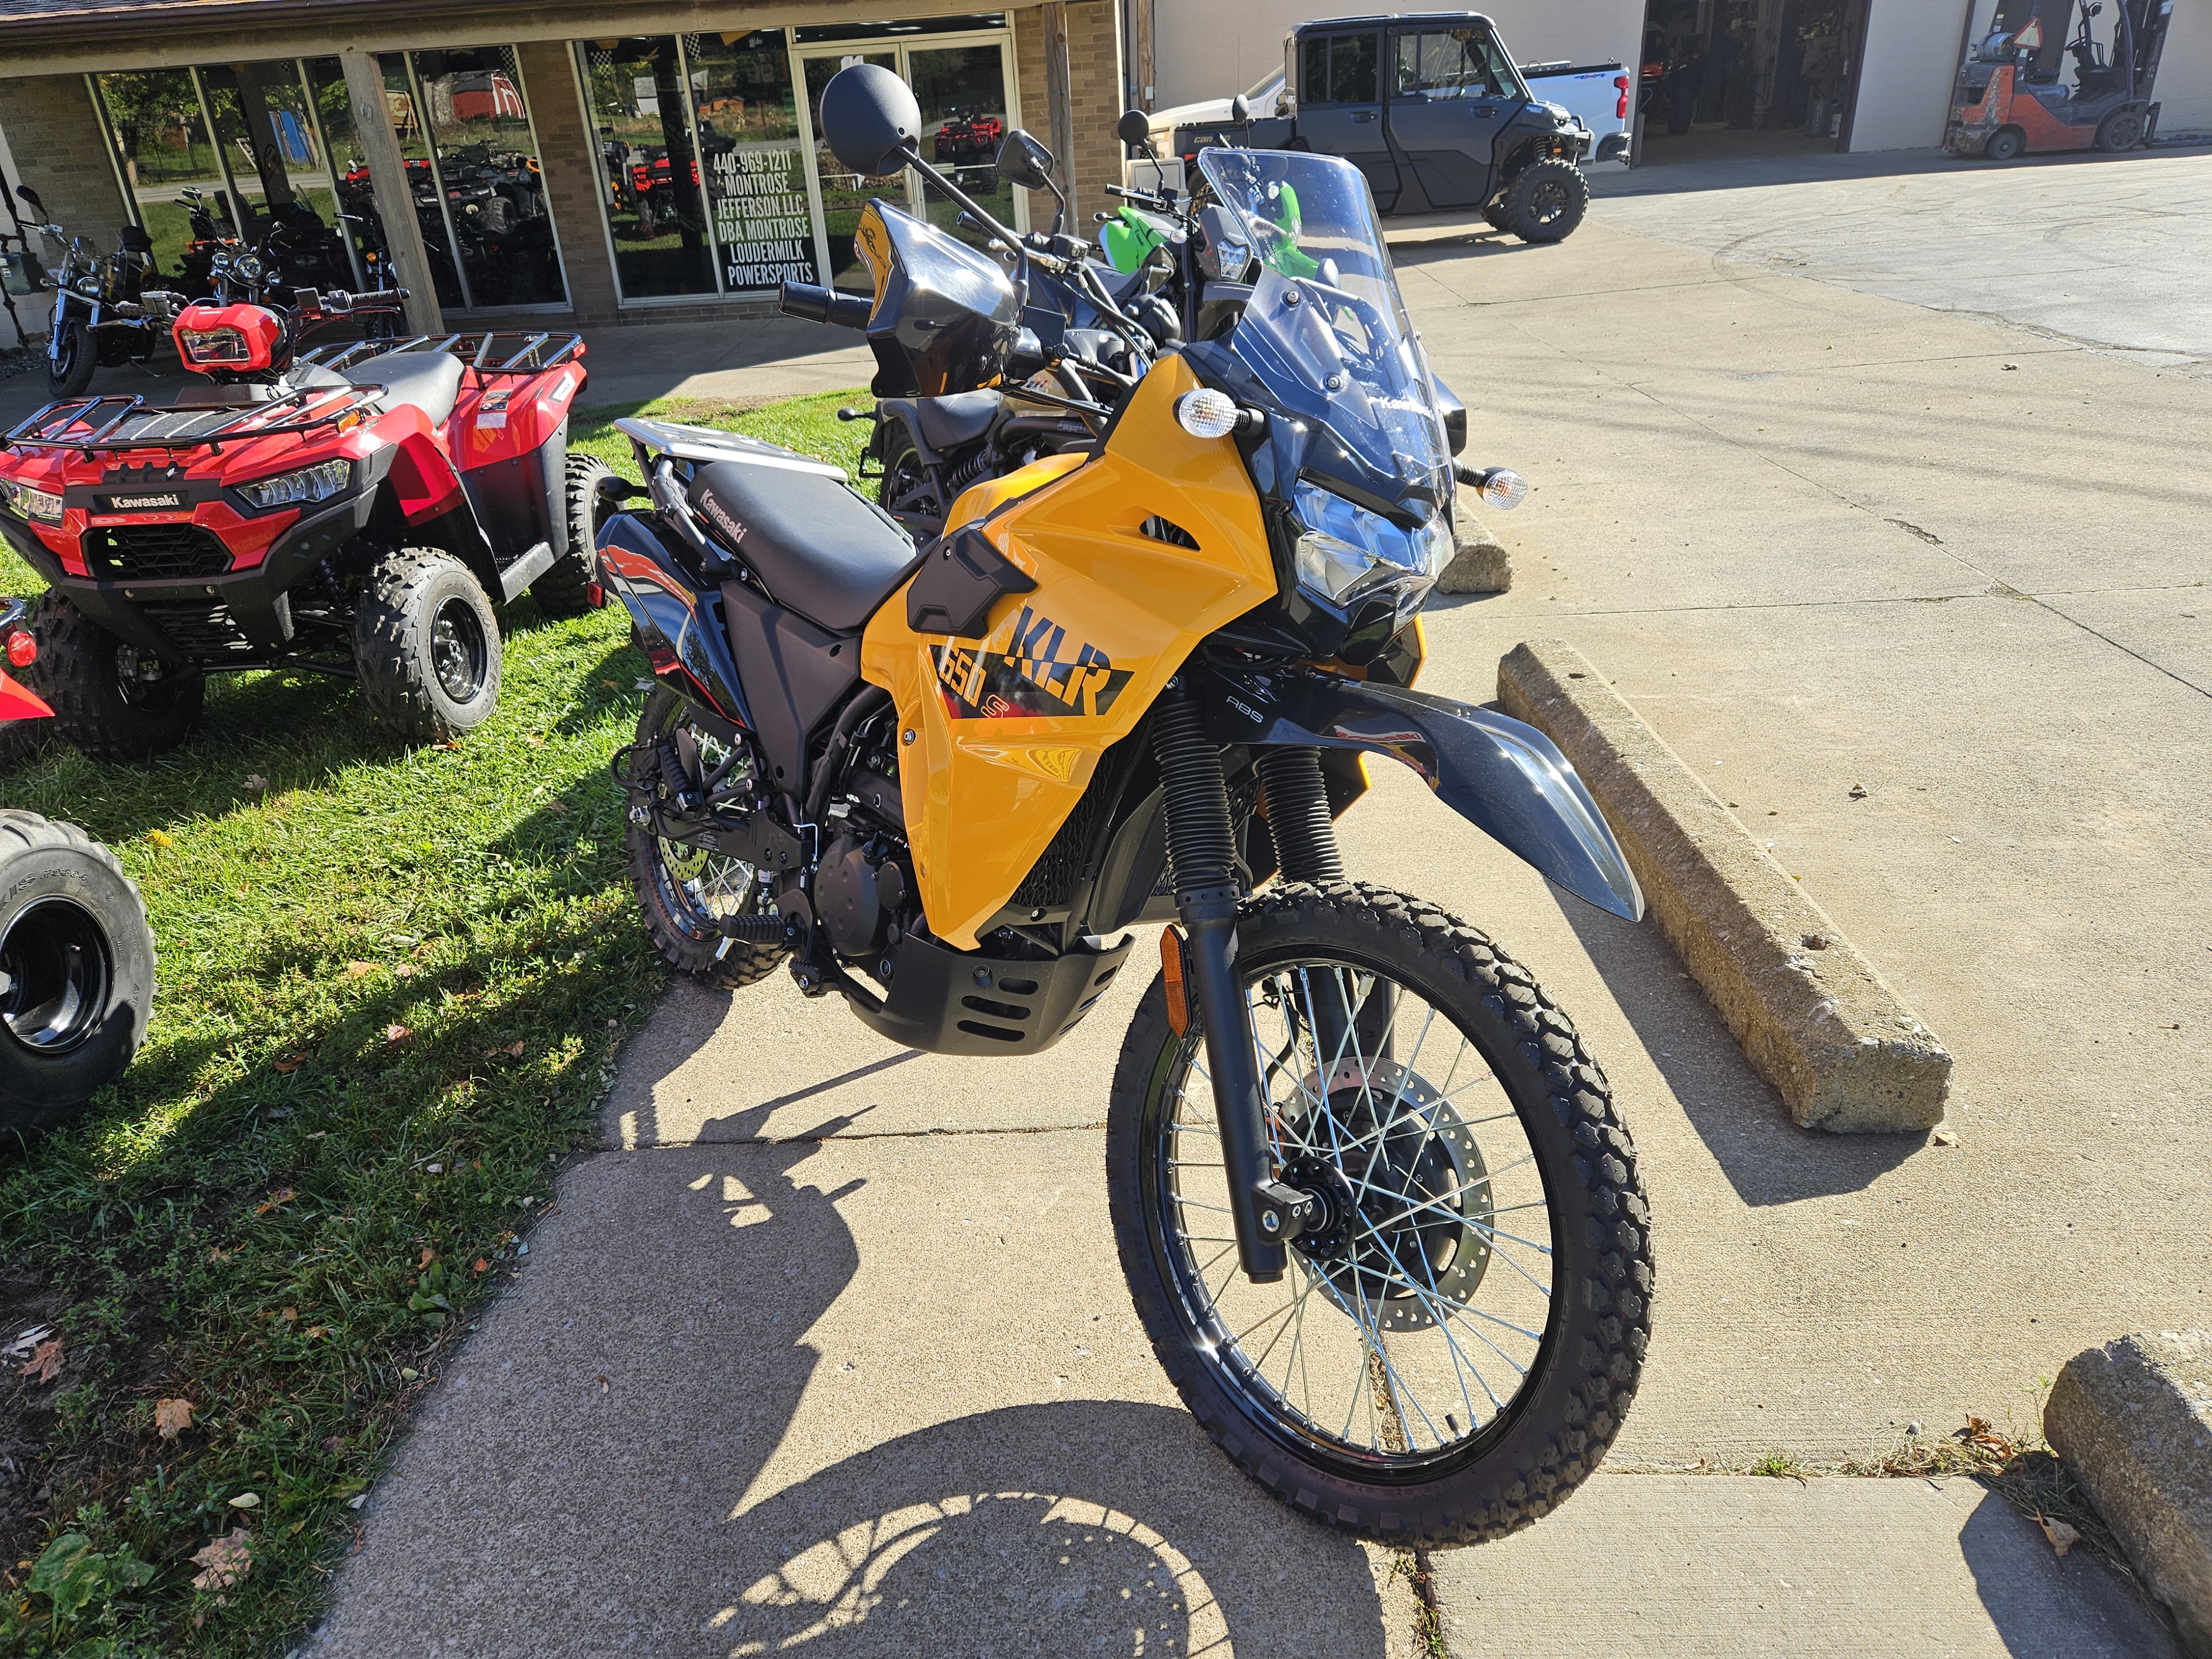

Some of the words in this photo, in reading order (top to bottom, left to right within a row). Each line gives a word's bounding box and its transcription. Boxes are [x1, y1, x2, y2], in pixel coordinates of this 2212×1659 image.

[713, 149, 791, 174] 440-969-1211
[724, 172, 790, 196] MONTROSE
[717, 196, 780, 220] JEFFERSON
[782, 194, 804, 216] LLC
[718, 221, 744, 242] DBA
[745, 217, 810, 241] MONTROSE
[730, 239, 805, 264] LOUDERMILK
[727, 262, 813, 286] POWERSPORTS
[111, 494, 180, 509] Kawasaki
[700, 489, 748, 544] Kawasaki
[1003, 605, 1111, 716] KLR
[939, 646, 987, 707] 650
[1226, 696, 1264, 723] ABS
